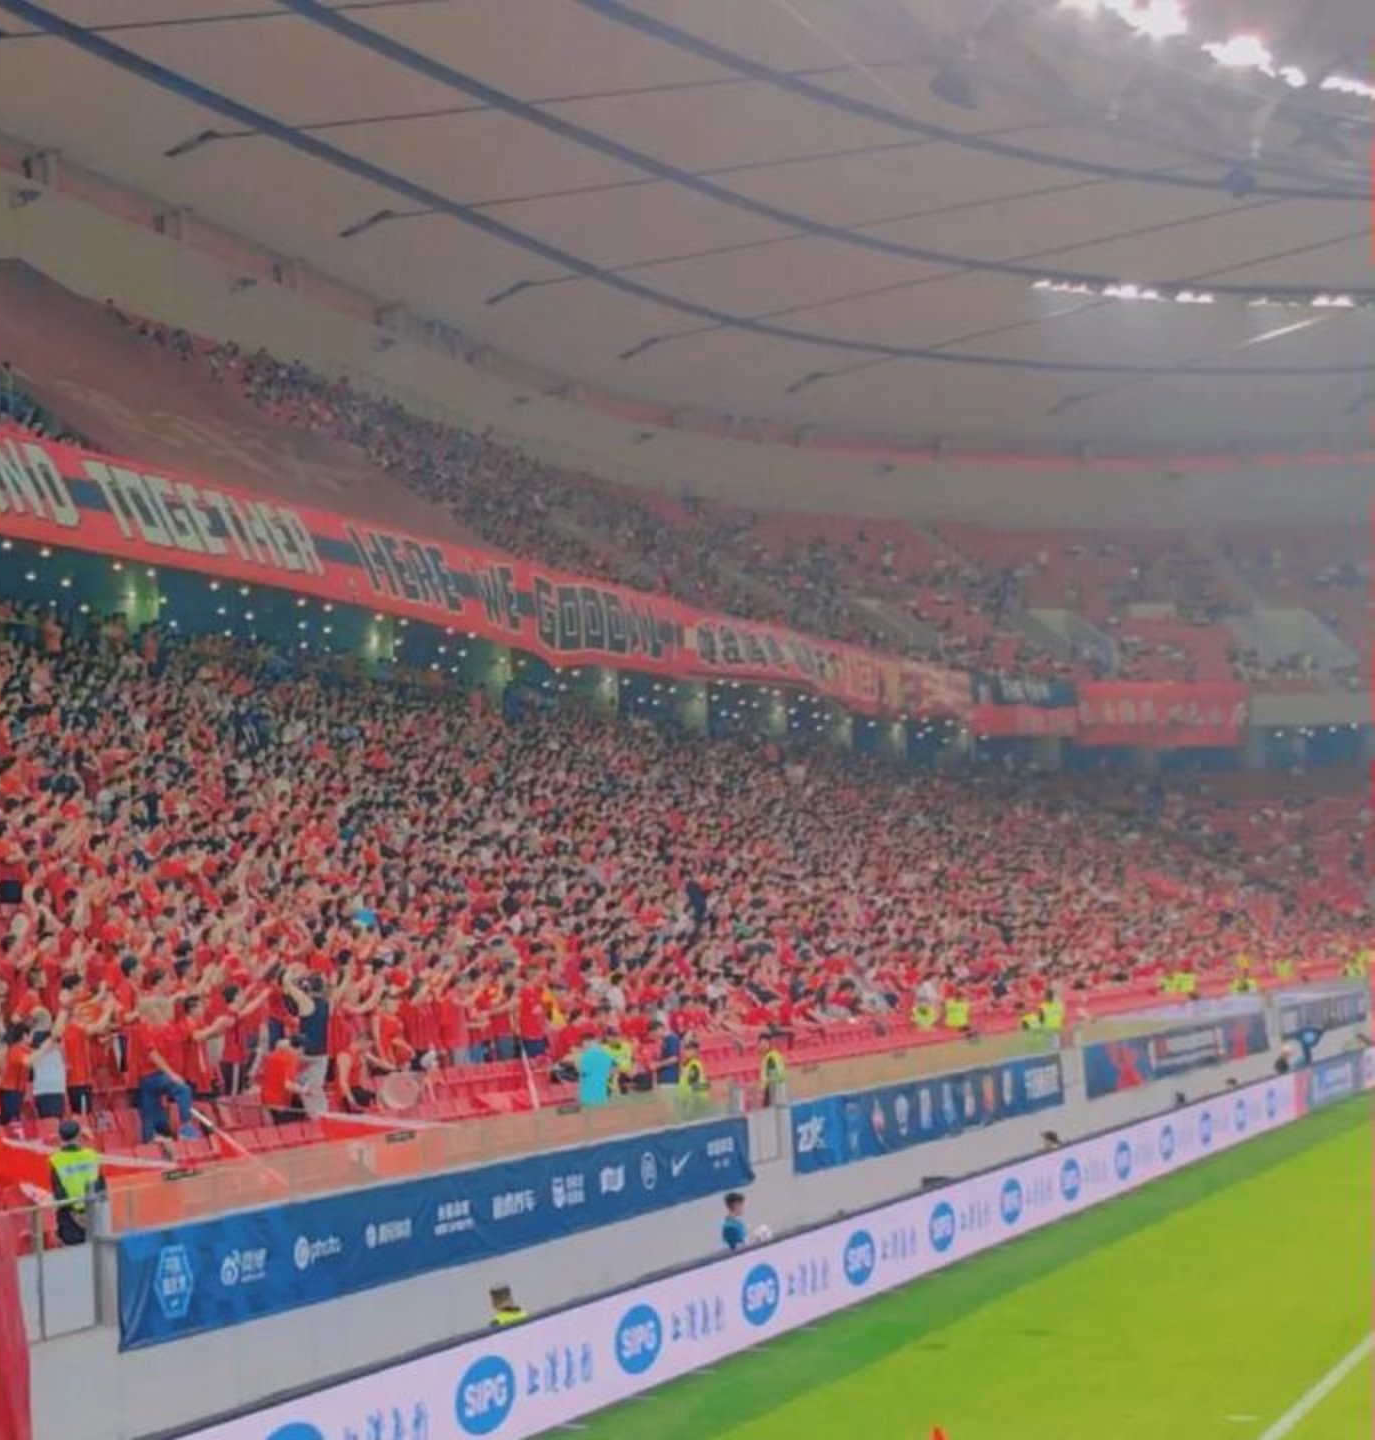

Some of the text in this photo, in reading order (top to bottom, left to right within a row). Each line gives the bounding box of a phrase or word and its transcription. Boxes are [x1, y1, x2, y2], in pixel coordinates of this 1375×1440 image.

[82, 459, 326, 576] TOGETHER
[345, 522, 464, 613] HERE
[620, 1319, 658, 1359] SIPG
[463, 1372, 508, 1418] SIPG
